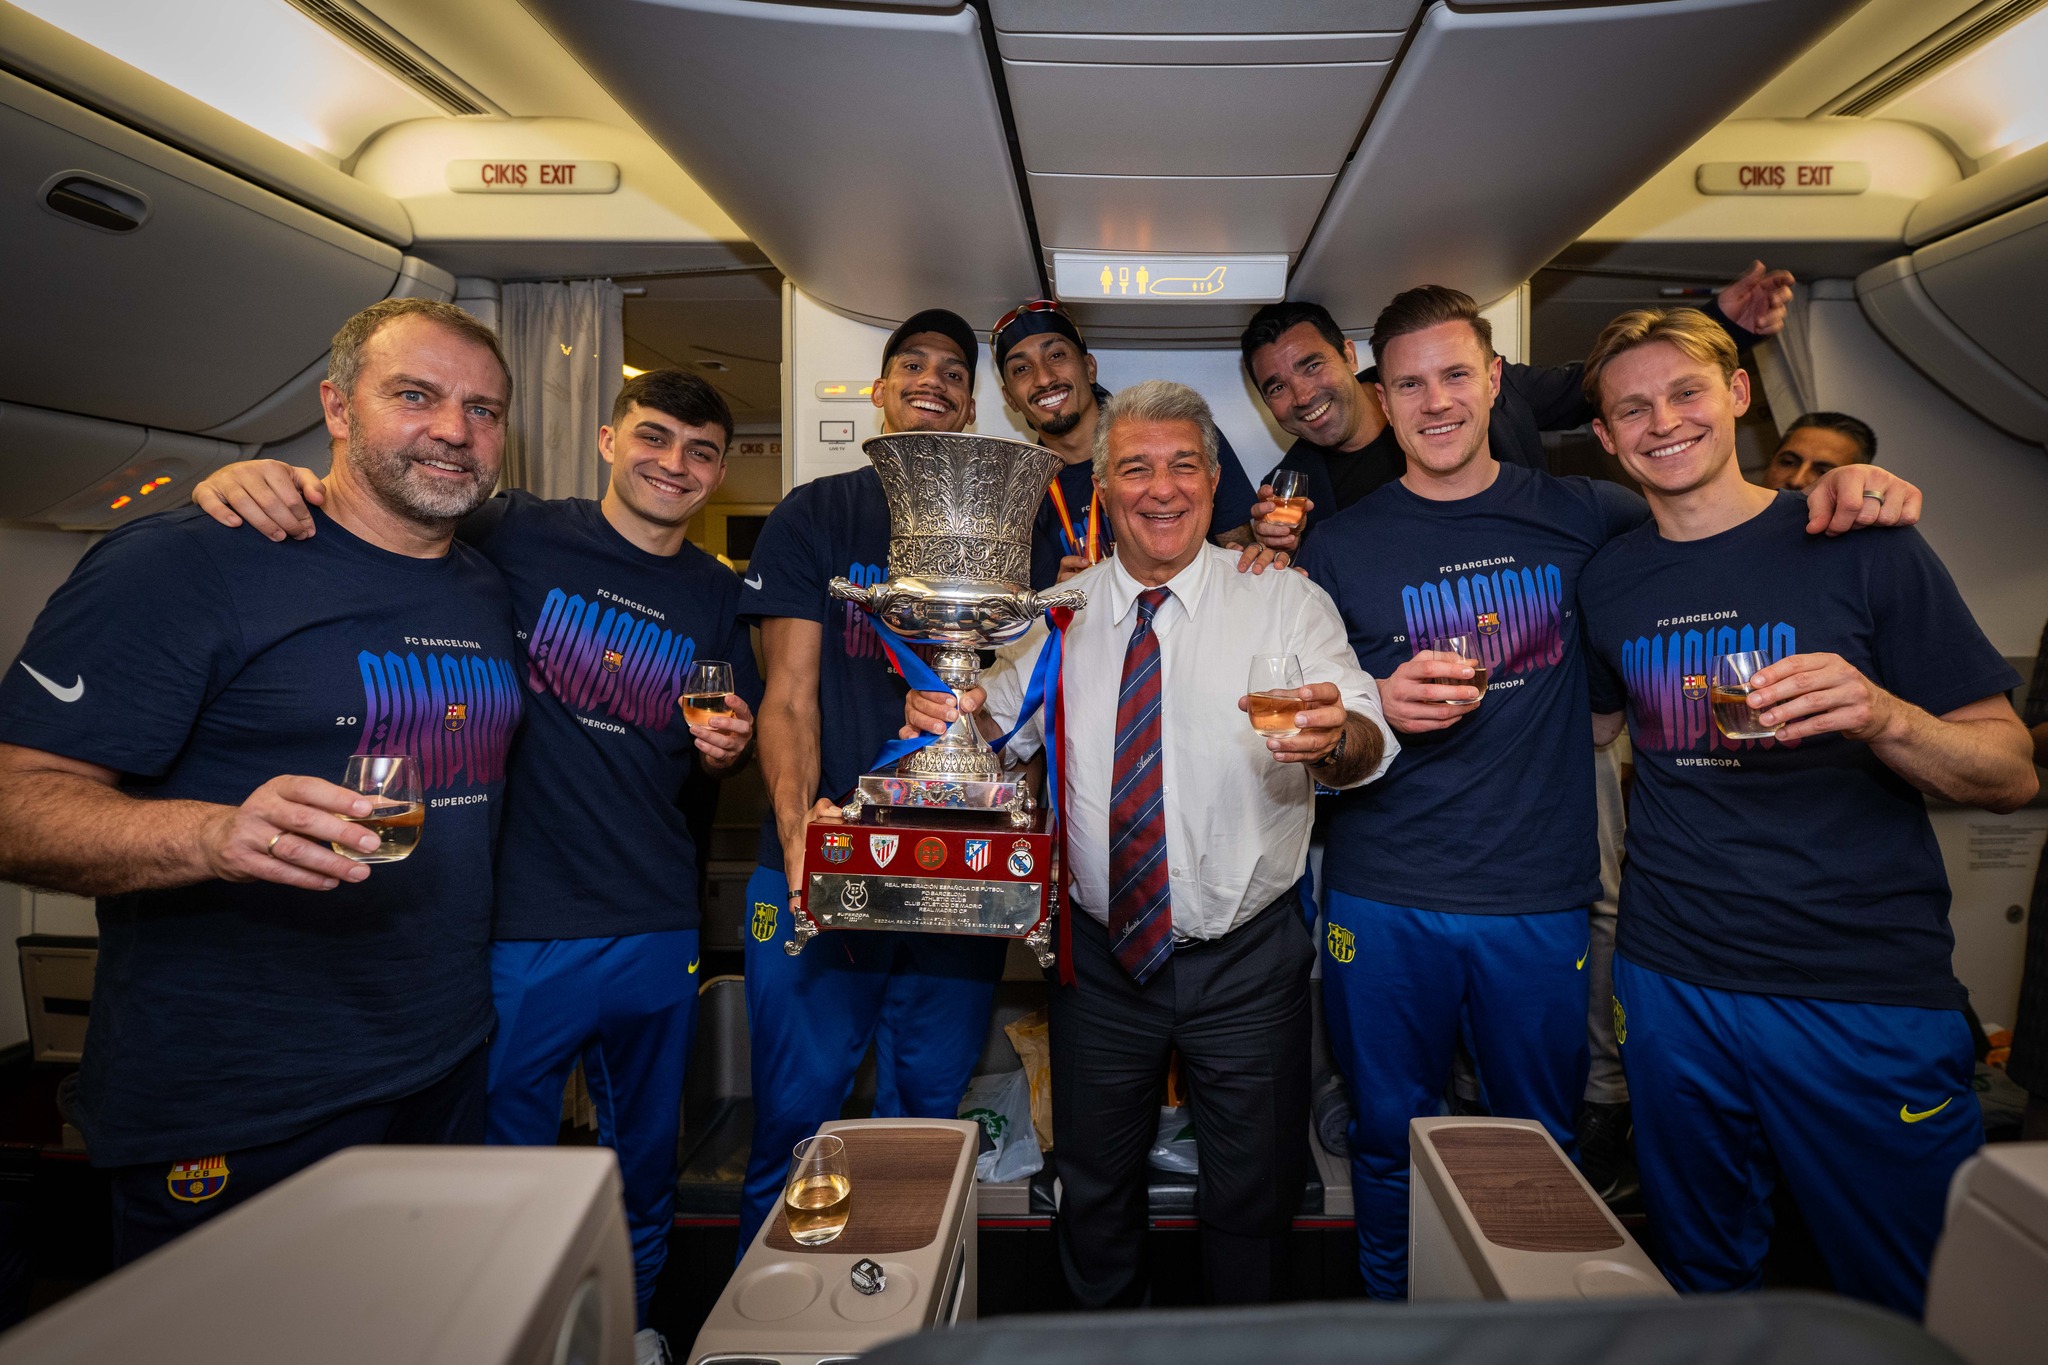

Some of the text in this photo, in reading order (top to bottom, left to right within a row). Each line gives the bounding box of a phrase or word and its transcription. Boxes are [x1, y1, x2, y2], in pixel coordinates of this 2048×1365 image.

[481, 164, 576, 188] ÇIKIŞ EXIT
[1739, 166, 1834, 190] ÇIKIŞ EXIT
[770, 443, 782, 454] EX
[1439, 555, 1516, 574] FC BARCELONA
[597, 588, 666, 621] FC BARCELONA
[1656, 610, 1739, 628] FC BARCELONA
[516, 630, 528, 640] 20
[1393, 635, 1406, 643] 20
[404, 636, 482, 650] FC BARCELONA
[1486, 678, 1525, 691] ERCOPA
[335, 716, 357, 726] 20
[1675, 757, 1741, 768] SUPERCOPA
[430, 793, 488, 808] SUPERCOPA
[922, 855, 939, 863] EF
[900, 882, 938, 890] FEDERACIÓN
[939, 884, 970, 892] ESPAÑOLA
[980, 885, 1004, 893] FÚTBOL
[185, 1170, 210, 1179] FCB
